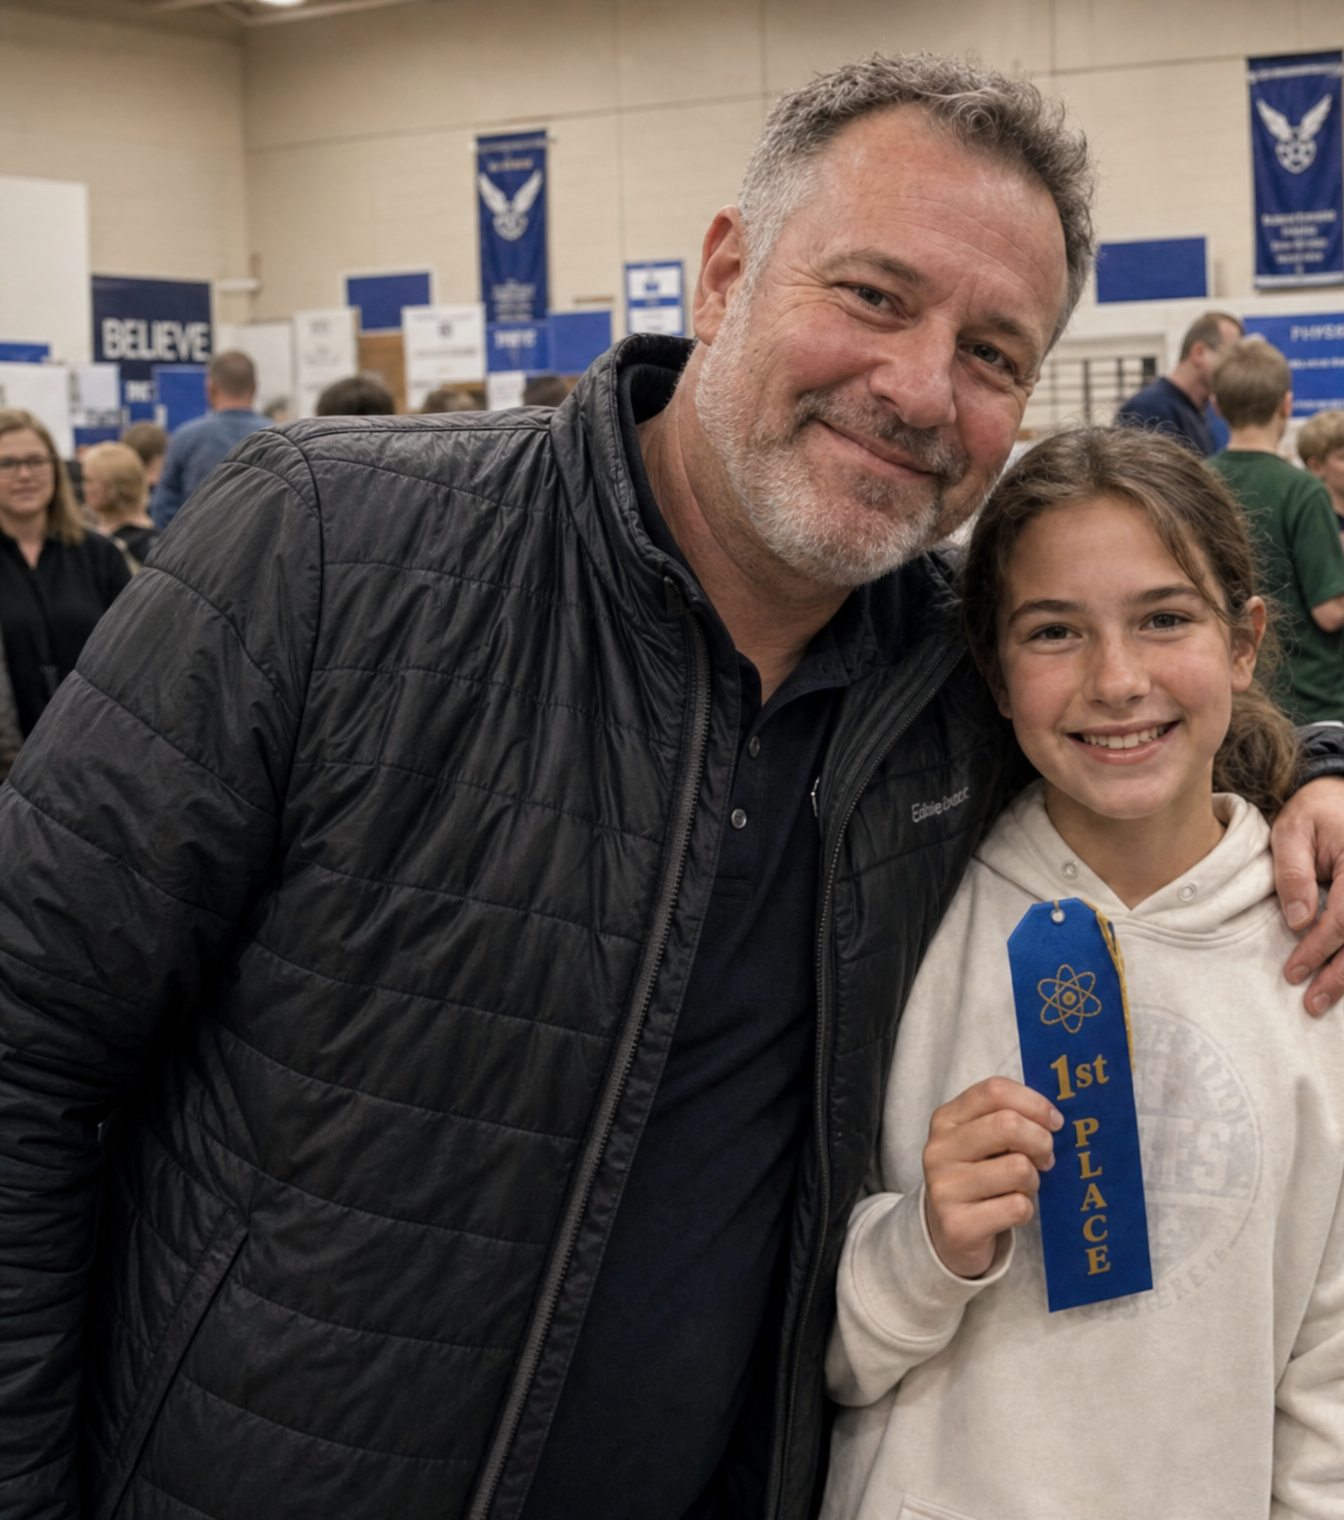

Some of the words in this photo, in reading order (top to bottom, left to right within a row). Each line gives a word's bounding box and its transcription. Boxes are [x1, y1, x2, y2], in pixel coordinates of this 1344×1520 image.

[102, 317, 210, 362] BELIEVE
[1050, 1053, 1110, 1101] 1st
[1072, 1117, 1111, 1276] PLACE
